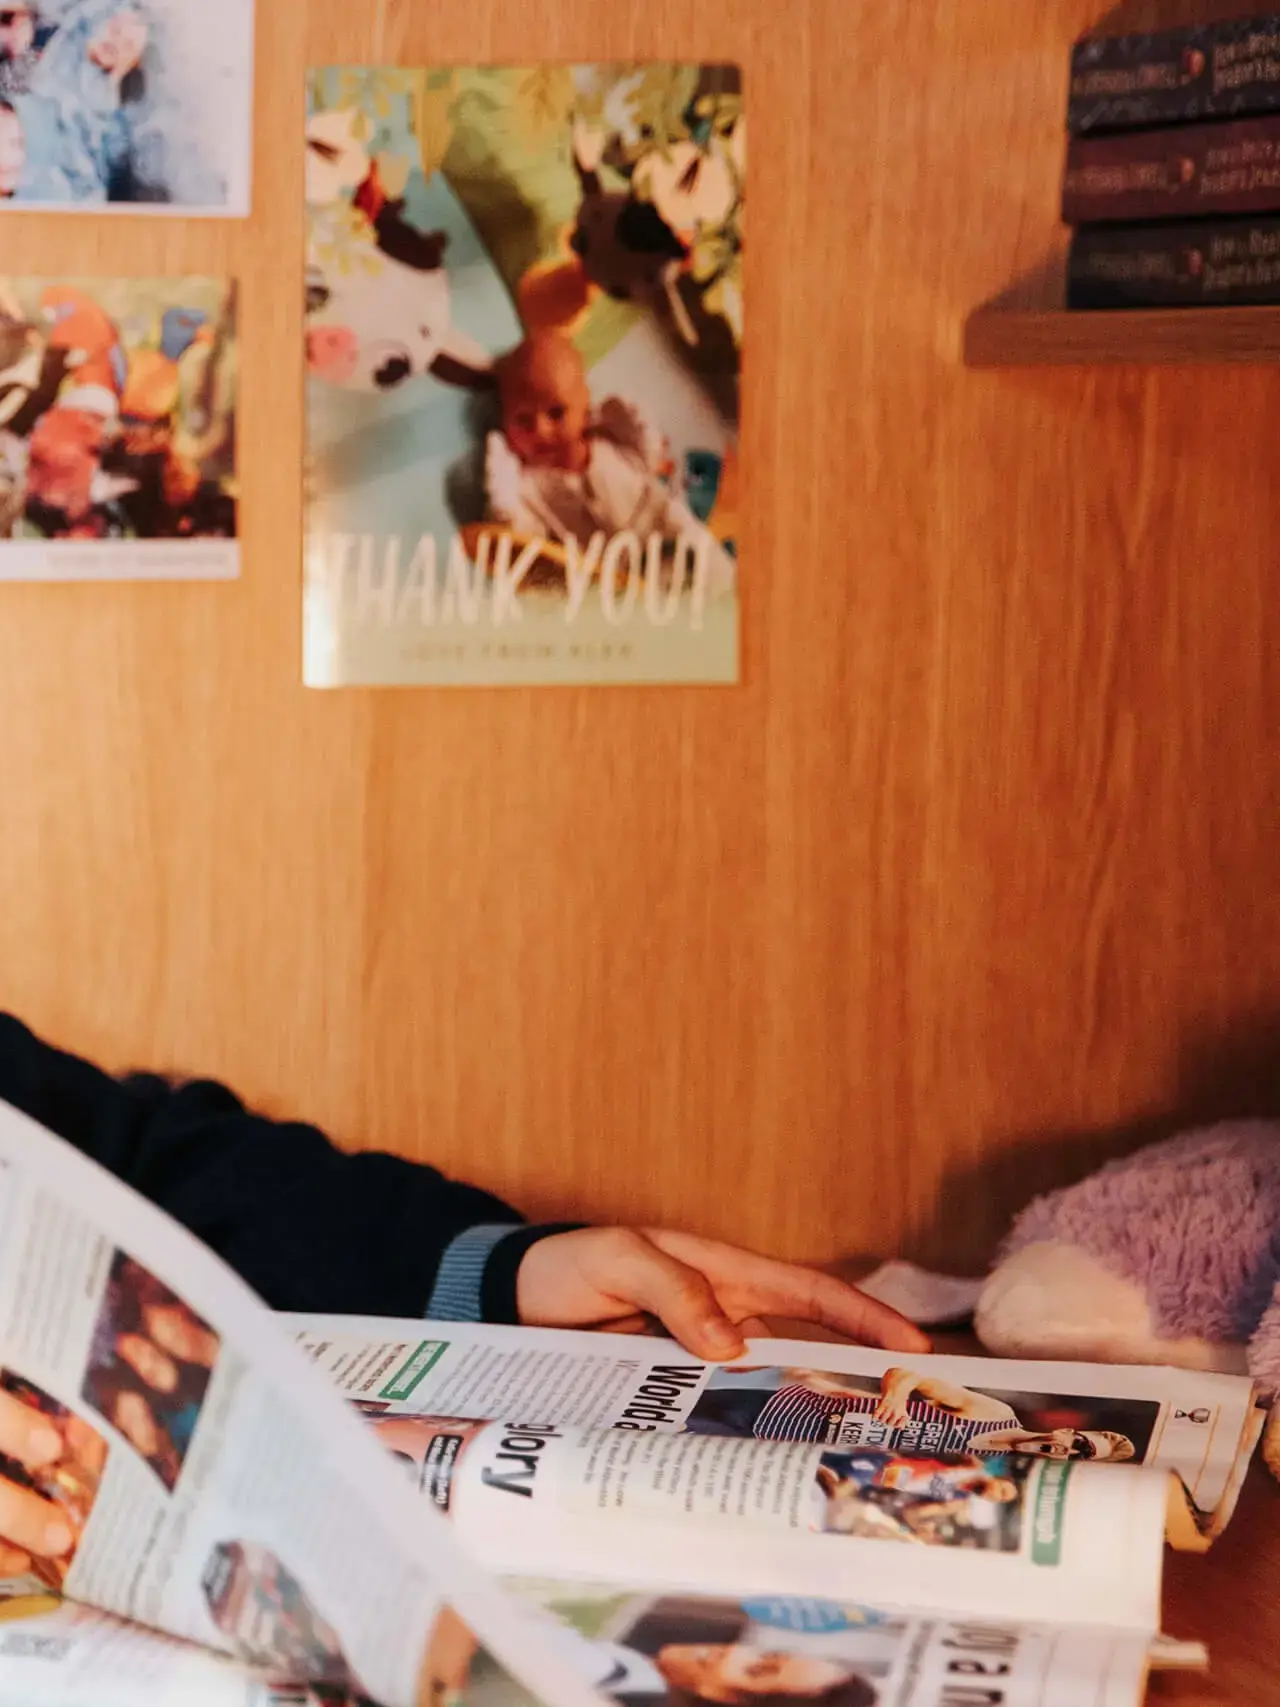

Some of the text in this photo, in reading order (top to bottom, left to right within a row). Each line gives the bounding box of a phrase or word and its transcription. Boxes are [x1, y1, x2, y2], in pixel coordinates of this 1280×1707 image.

[308, 531, 543, 627] THANK
[620, 1364, 707, 1424] World
[480, 1422, 564, 1499] glory
